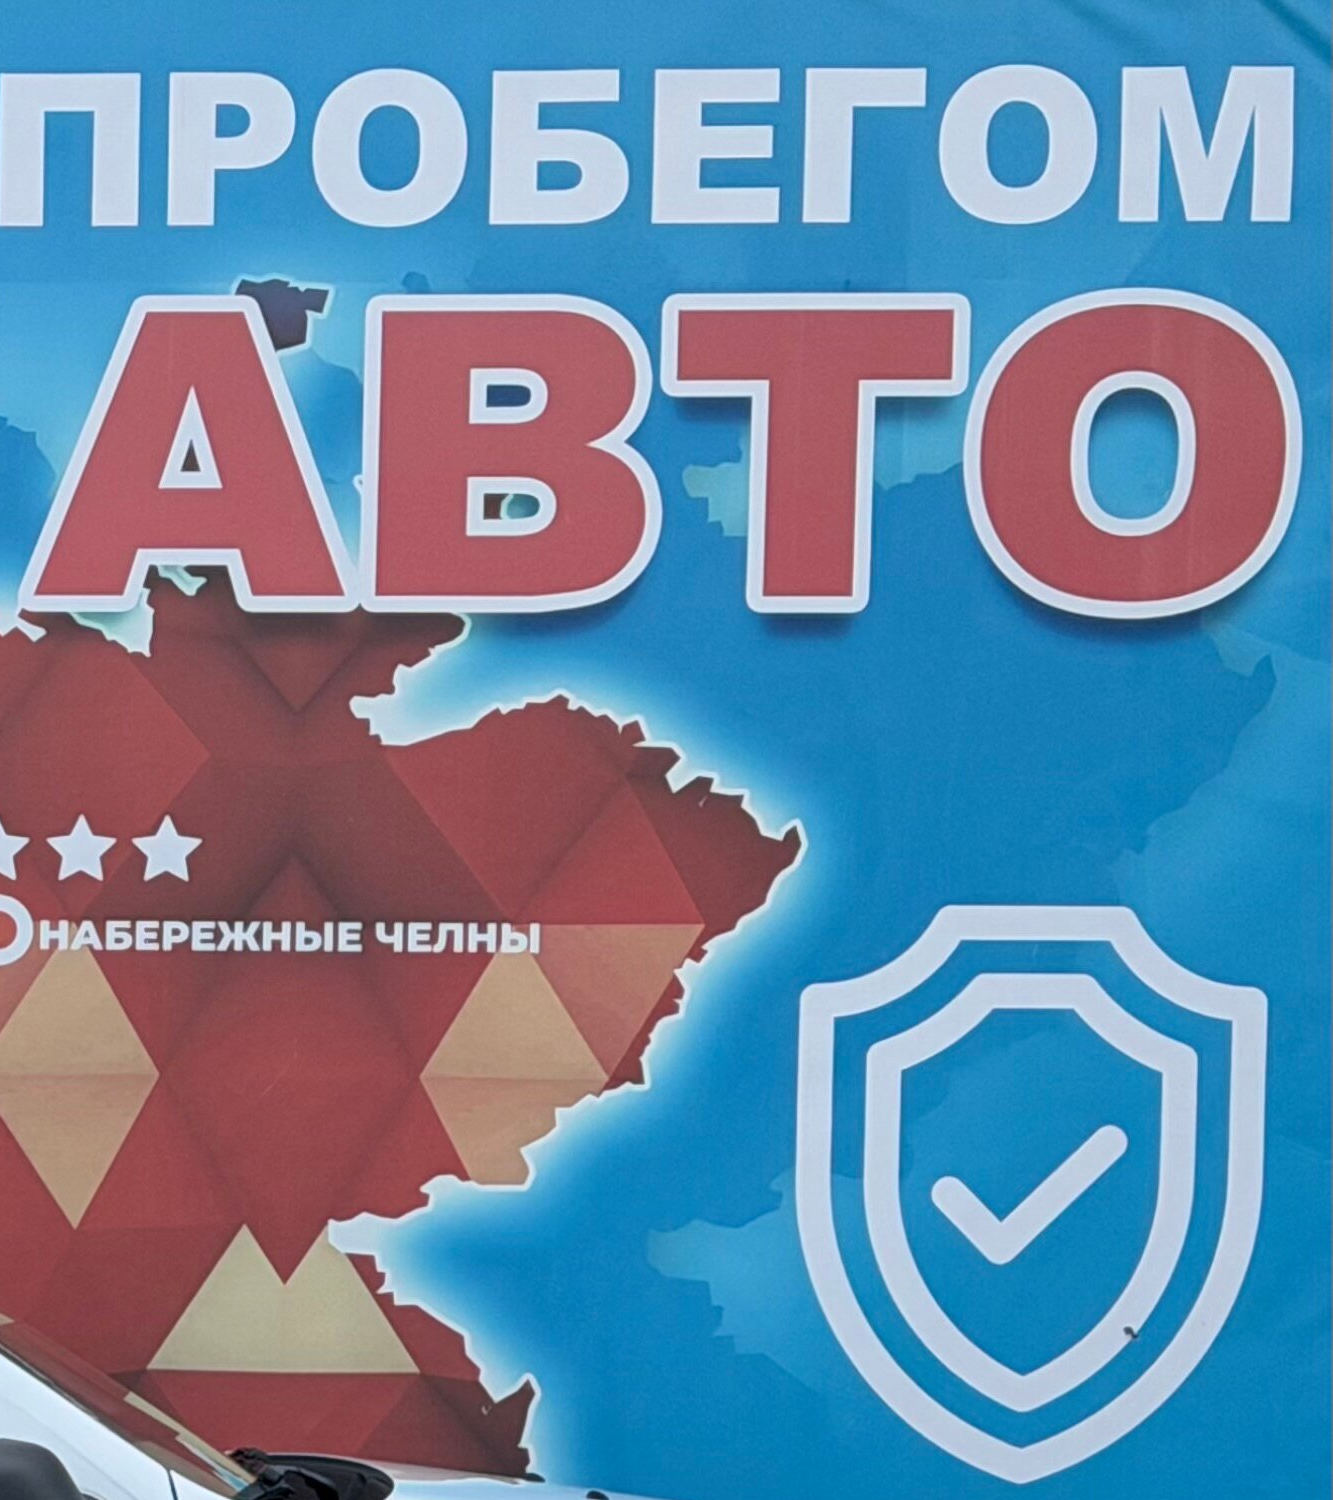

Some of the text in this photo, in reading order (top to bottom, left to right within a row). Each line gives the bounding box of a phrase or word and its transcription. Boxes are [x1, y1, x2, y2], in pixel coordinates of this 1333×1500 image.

[18, 288, 1302, 618] АВТО
[39, 919, 541, 954] НАБЕРЕЖНЫЕ ЧЕЛНЫ
